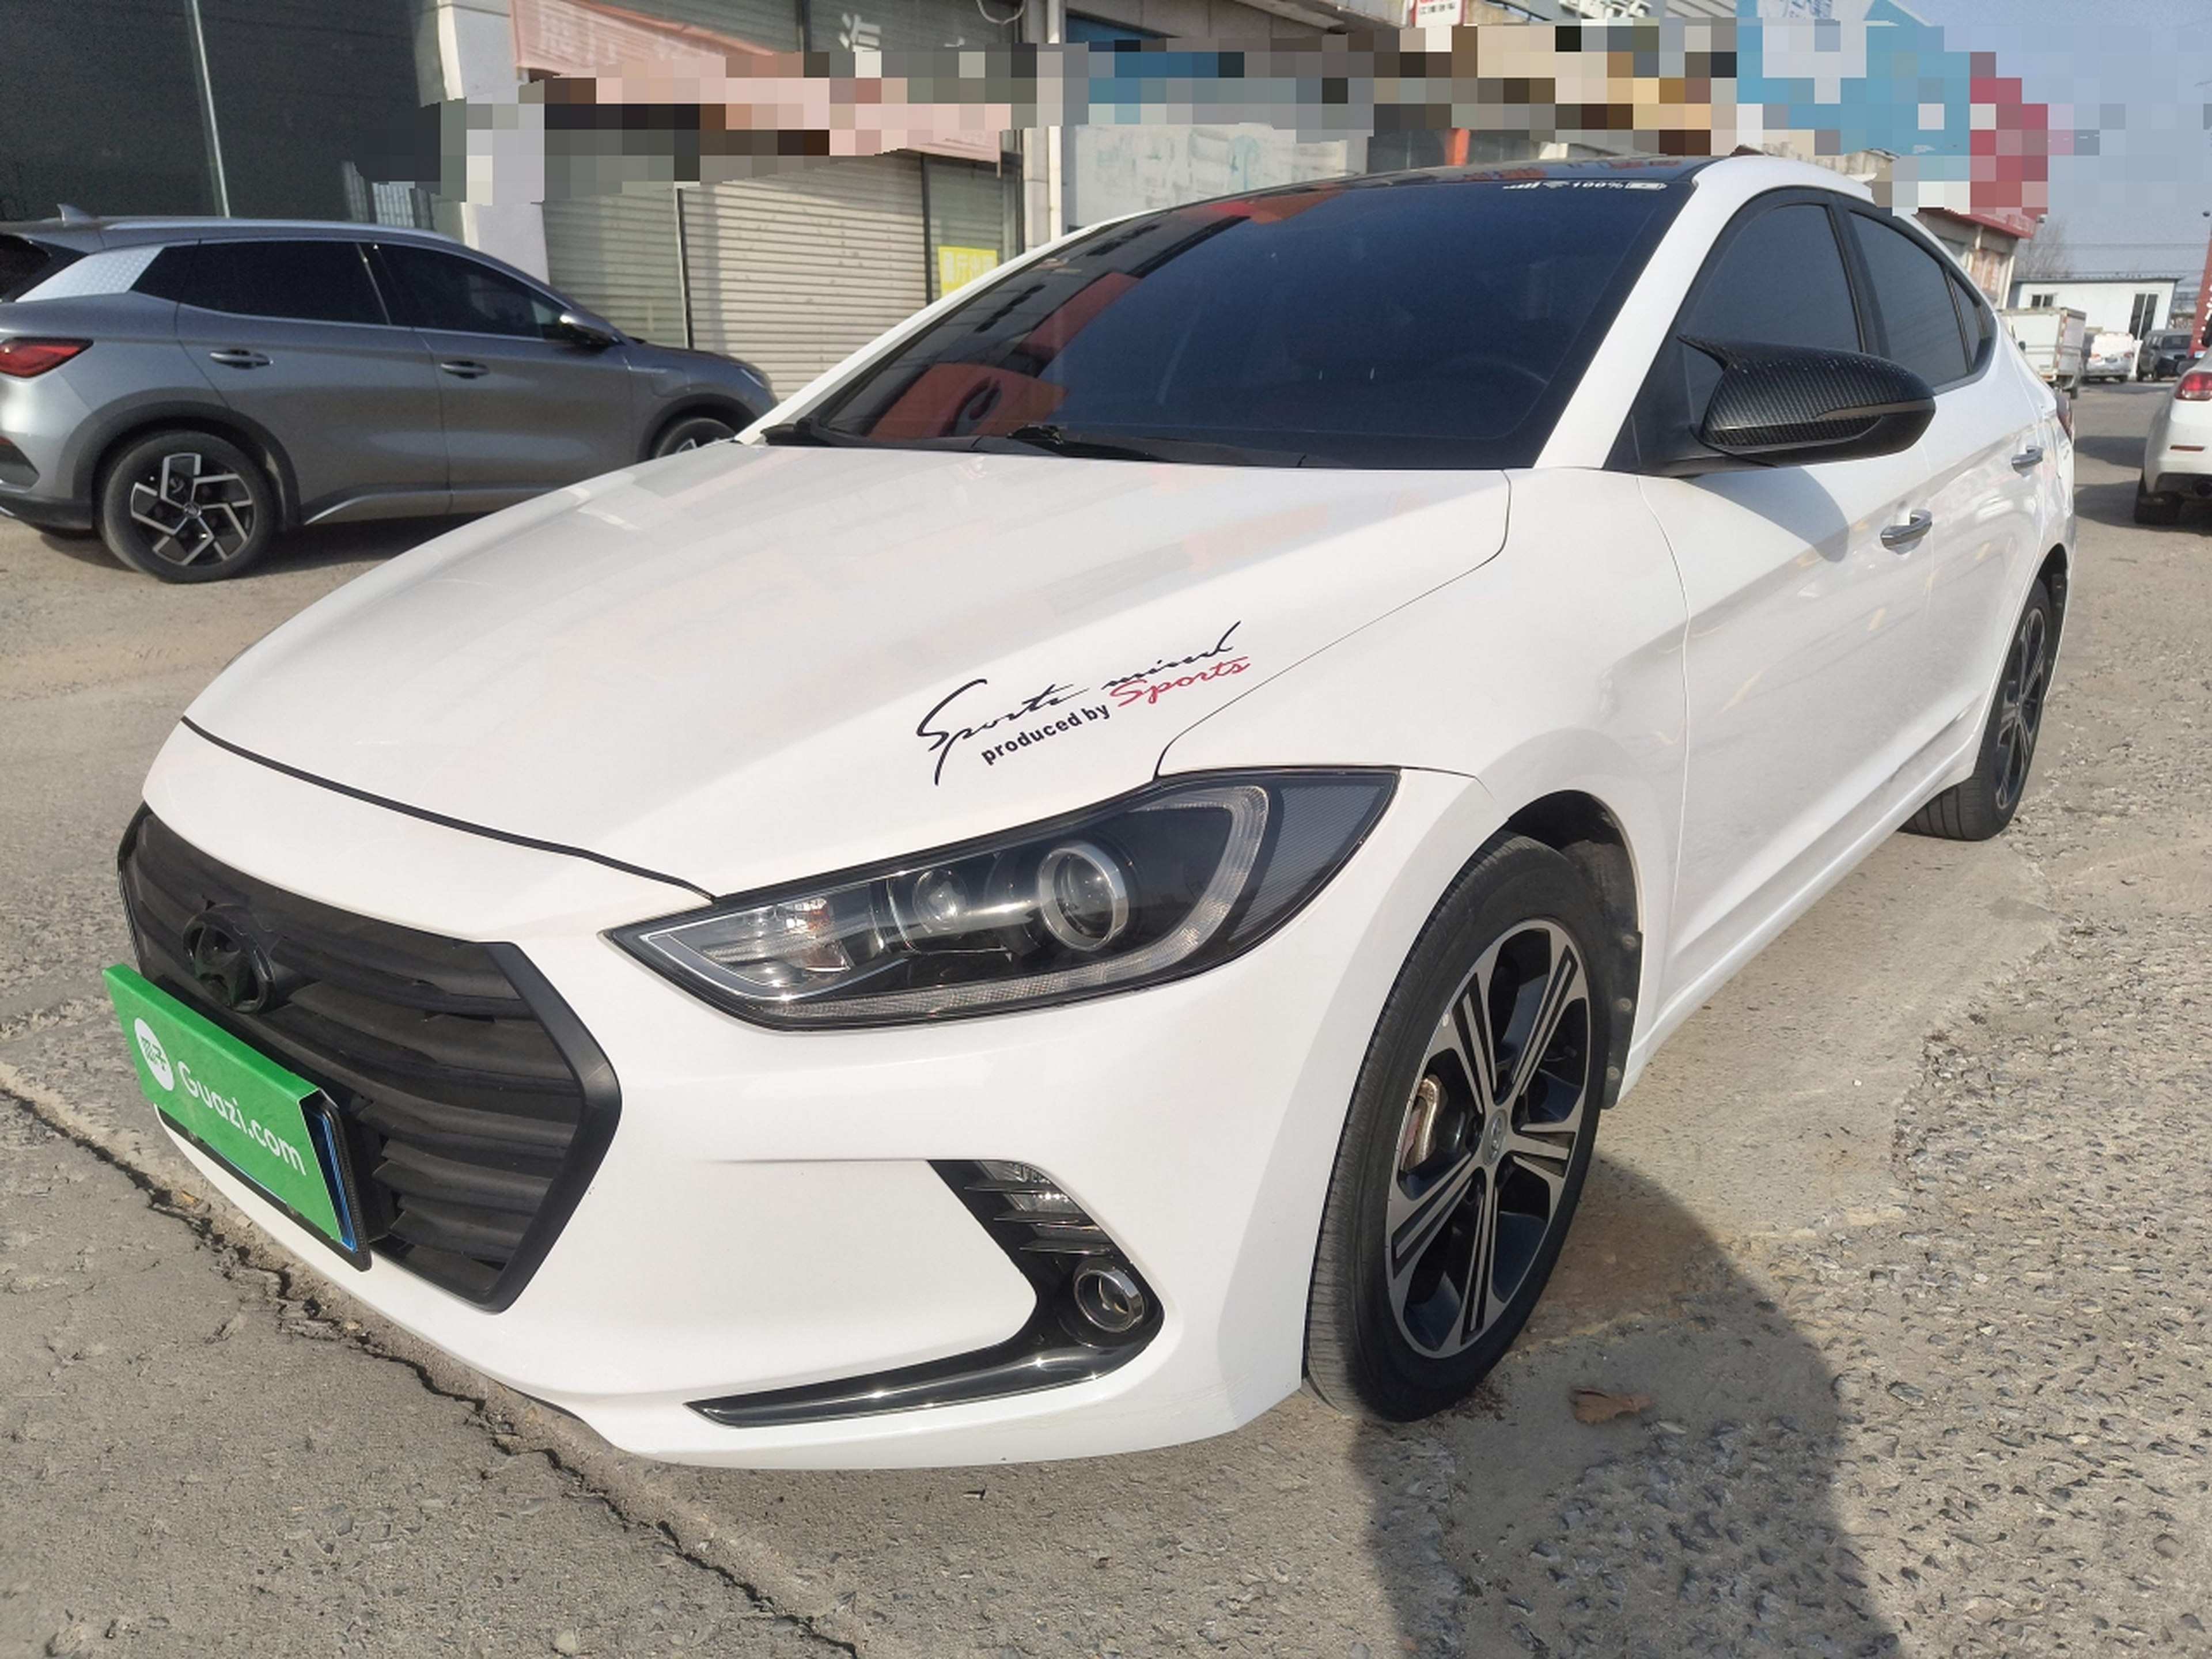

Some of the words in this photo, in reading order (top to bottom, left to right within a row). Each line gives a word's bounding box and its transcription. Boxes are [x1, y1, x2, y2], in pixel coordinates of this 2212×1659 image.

[981, 713, 1082, 766] produced
[1081, 704, 1110, 721] by
[1109, 656, 1251, 707] Sports
[177, 1060, 306, 1176] Guazi.com
